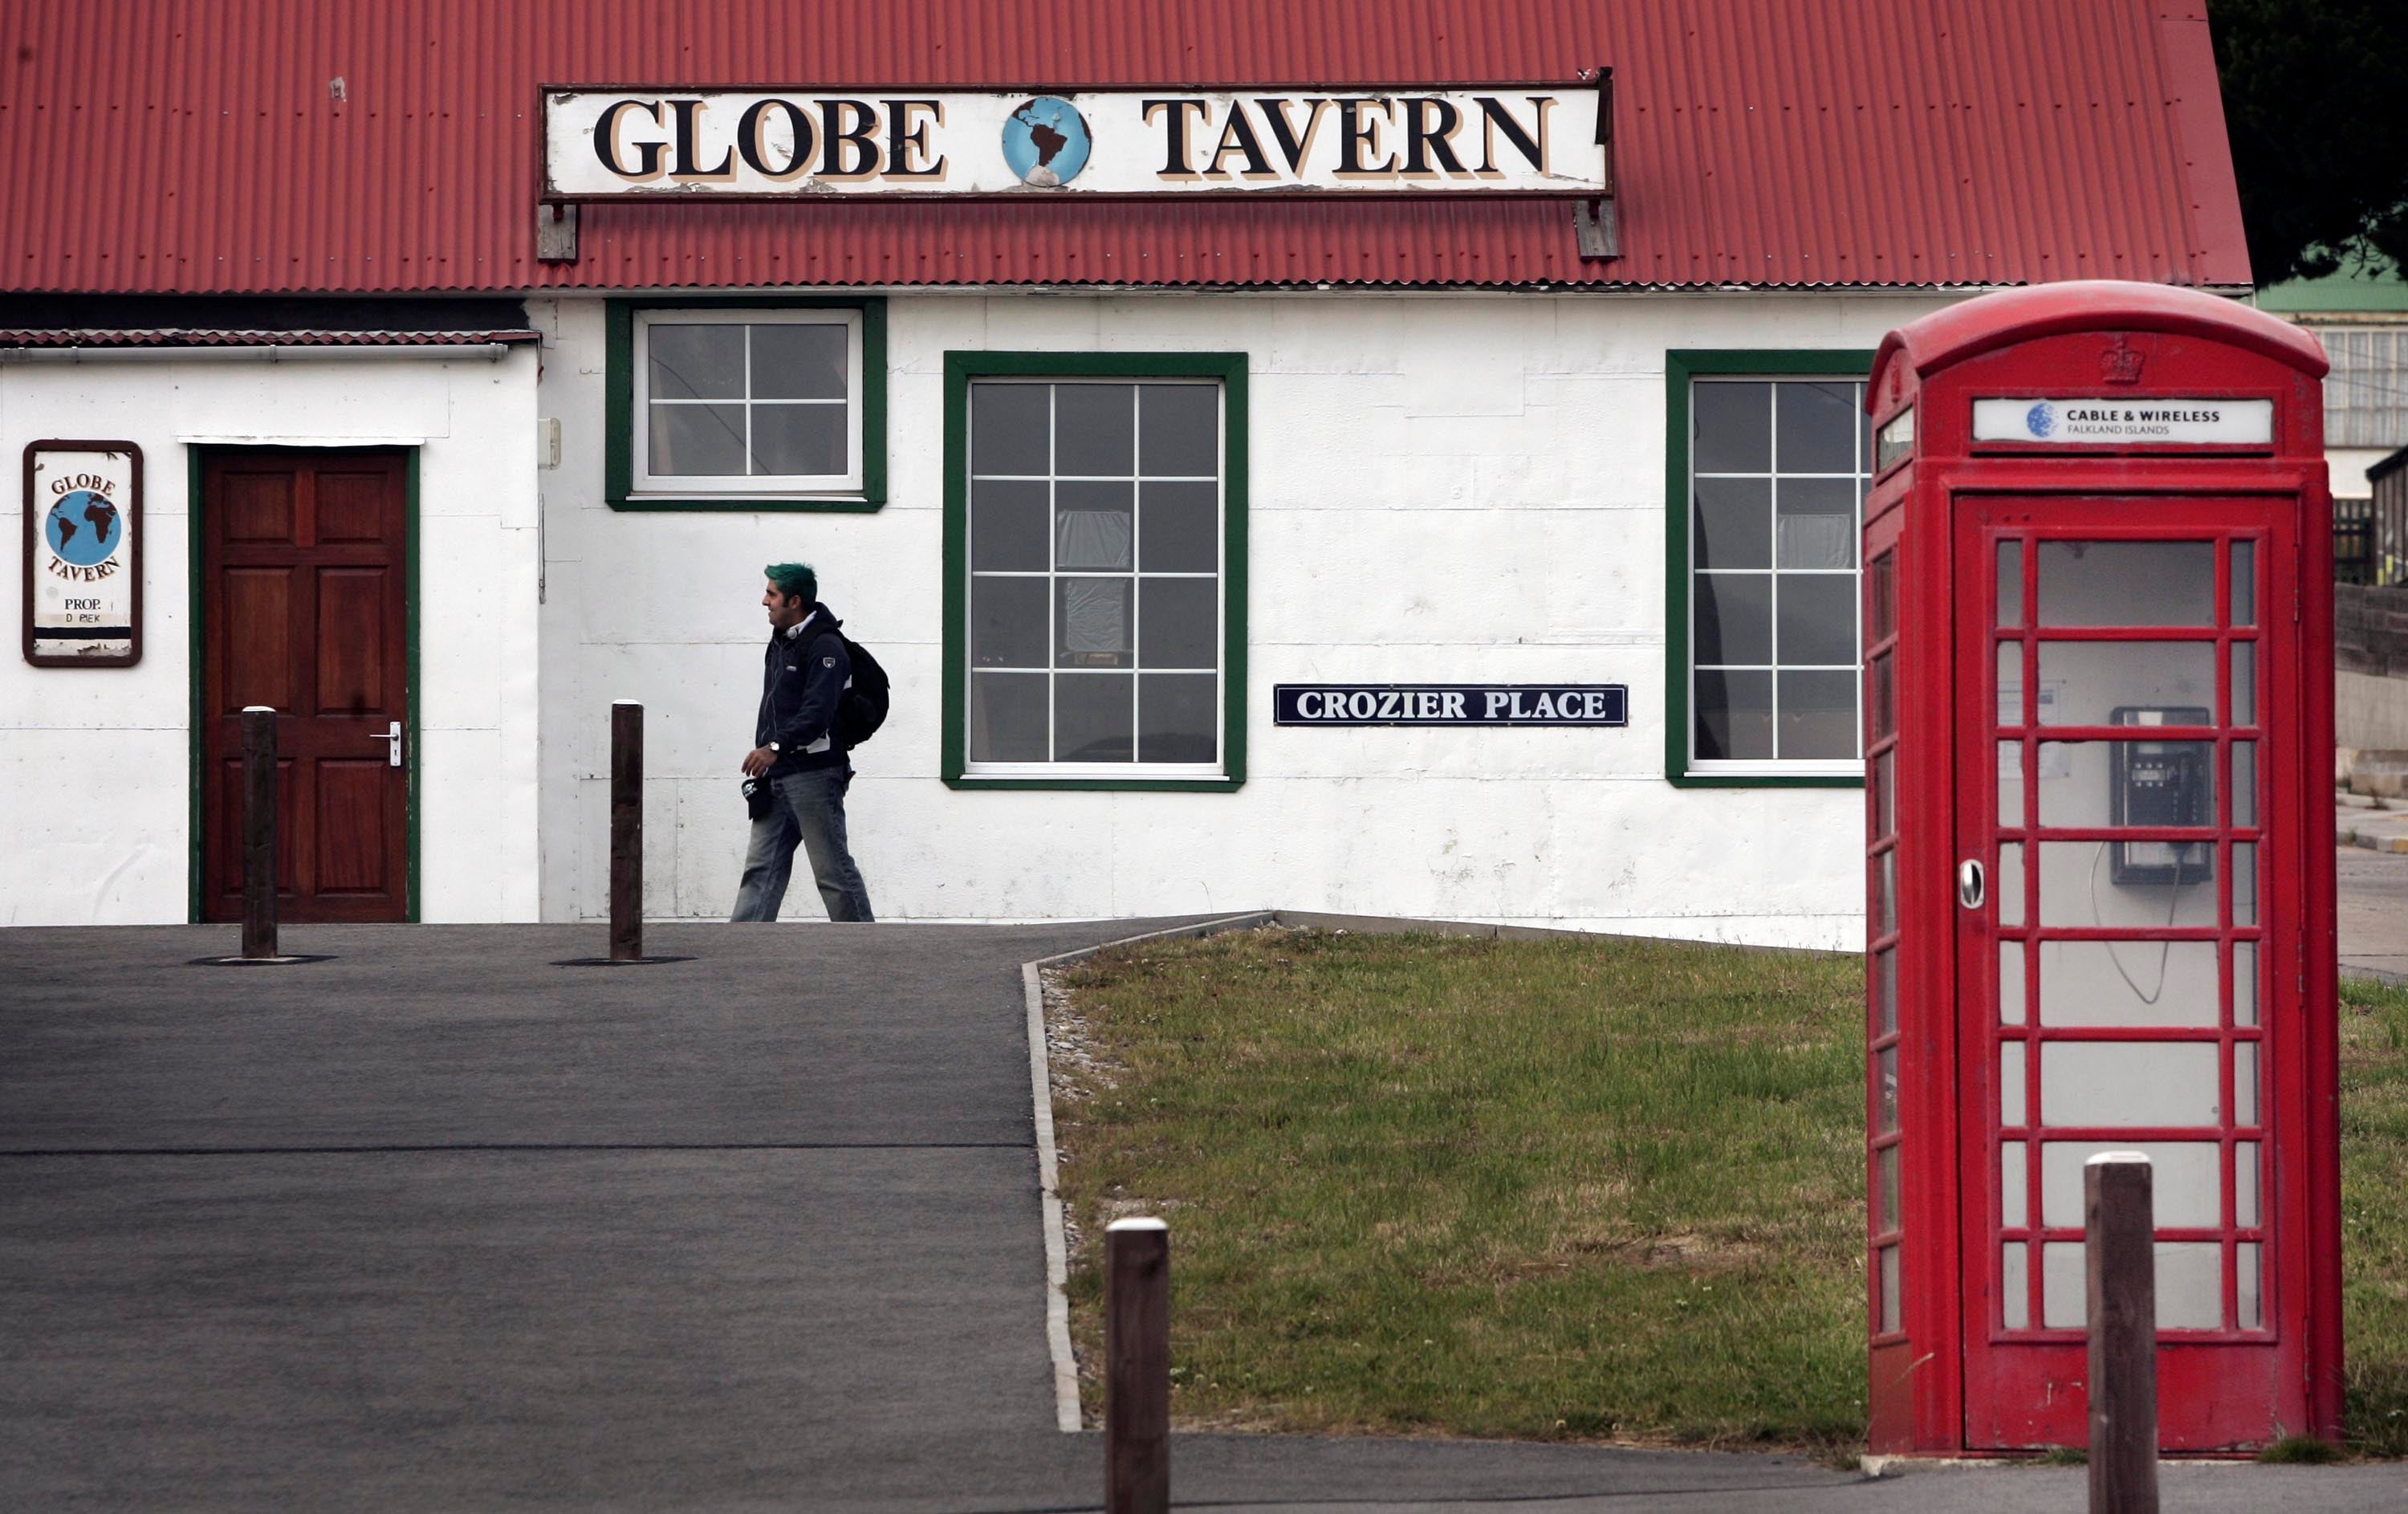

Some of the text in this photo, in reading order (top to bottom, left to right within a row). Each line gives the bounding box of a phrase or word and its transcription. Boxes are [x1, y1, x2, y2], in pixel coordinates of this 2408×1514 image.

[593, 96, 1560, 183] GLOBE TAVERN
[2067, 409, 2221, 423] CABLE & WIRELESS
[2067, 424, 2170, 436] FALKLAND ISLANDS
[51, 473, 116, 496] GLOBE
[47, 556, 121, 583] TAVERN
[64, 598, 101, 610] PROP.
[1296, 691, 1606, 719] CROZIER PLACE
